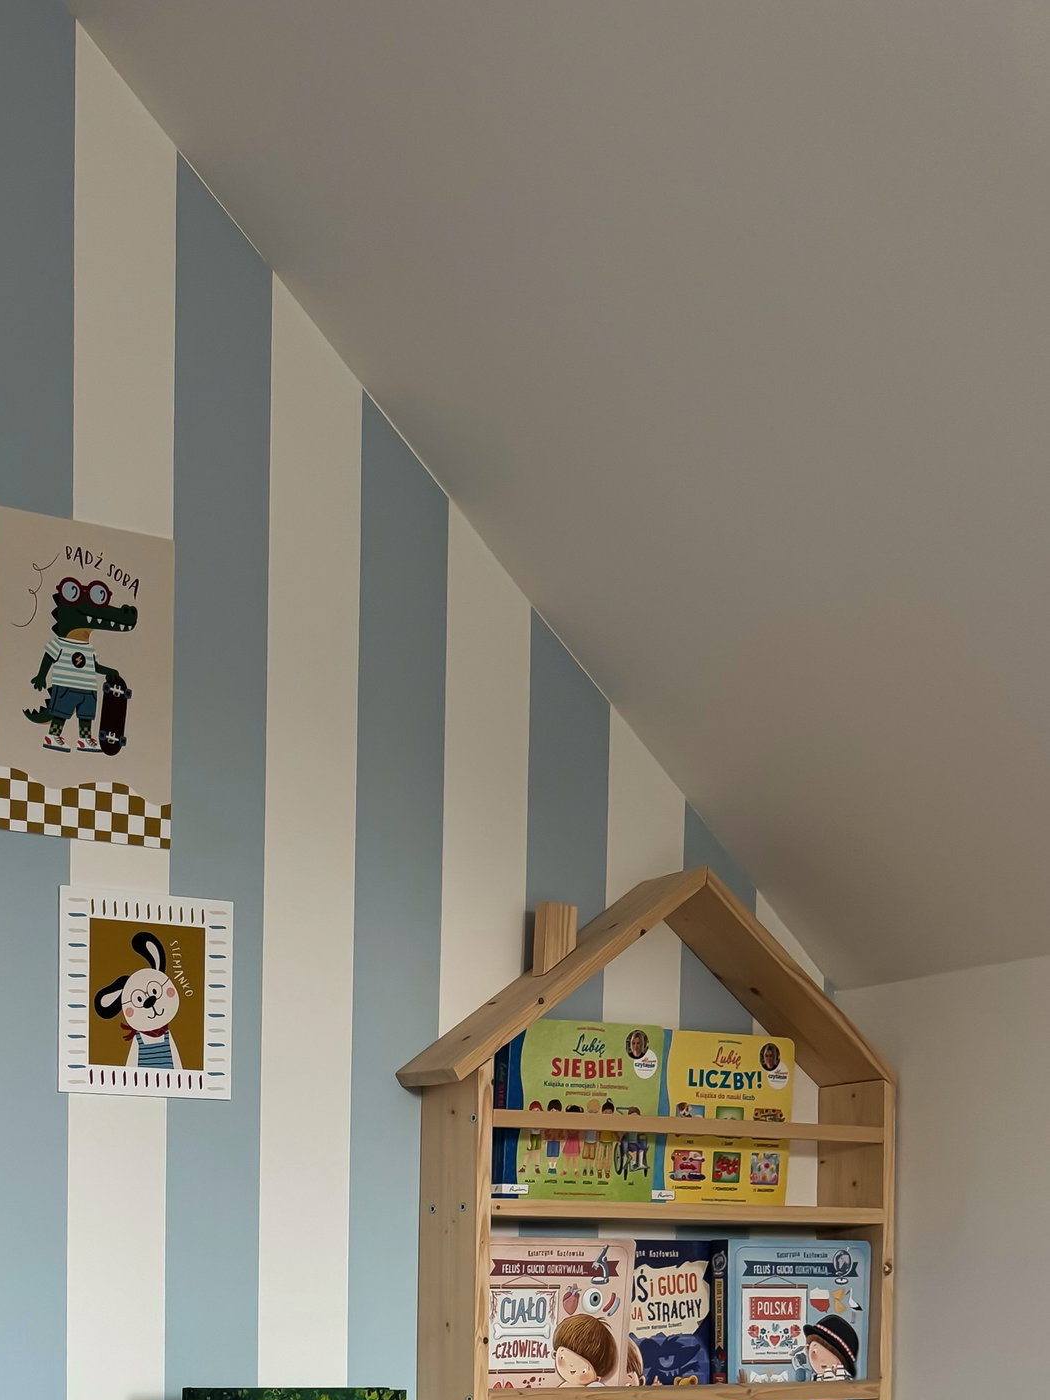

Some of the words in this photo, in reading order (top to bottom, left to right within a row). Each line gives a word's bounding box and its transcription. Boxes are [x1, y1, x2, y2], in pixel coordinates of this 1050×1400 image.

[169, 940, 194, 997] SIEMANKO
[573, 1033, 606, 1058] Lubię
[551, 1057, 623, 1080] SIEBIE!
[713, 1046, 742, 1069] Lubię
[688, 1068, 762, 1091] LICZBY!
[649, 1249, 679, 1258] Kozłowska
[501, 1263, 521, 1274] FELUŚ
[526, 1264, 546, 1274] GUCIO
[753, 1263, 771, 1274] FELUŚ
[776, 1265, 794, 1275] GUCIO
[649, 1278, 654, 1297] i
[658, 1272, 698, 1296] GUCIO
[500, 1296, 547, 1326] CIAŁO
[647, 1298, 702, 1322] STRACHY
[757, 1301, 794, 1316] POLSKA
[492, 1339, 550, 1359] CZŁOWIEKA
